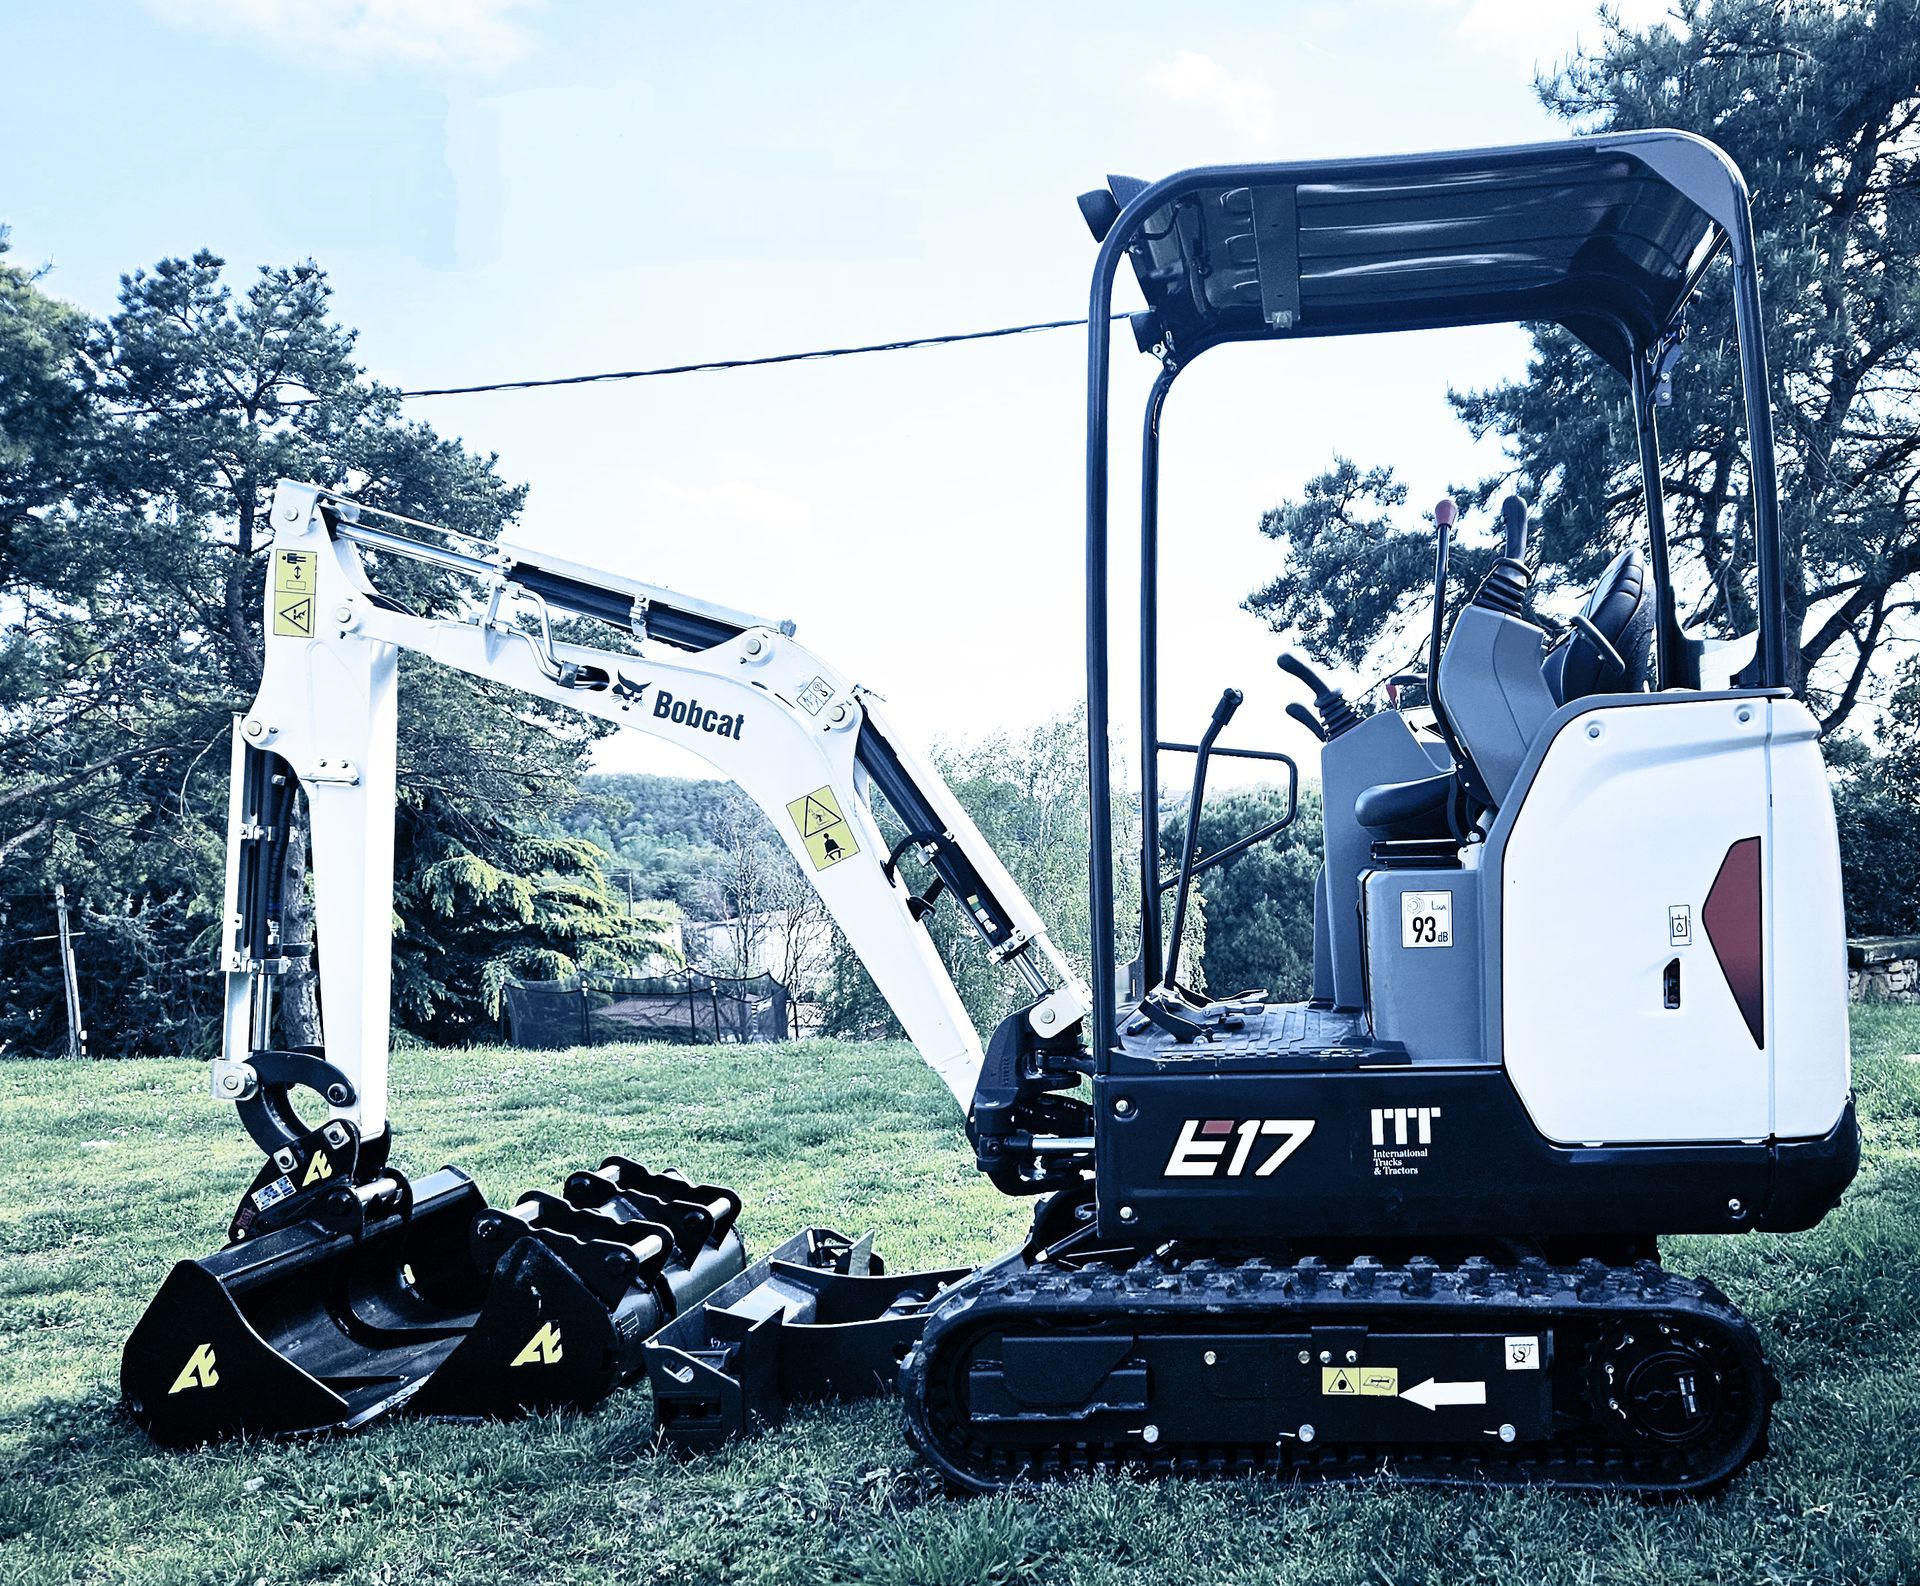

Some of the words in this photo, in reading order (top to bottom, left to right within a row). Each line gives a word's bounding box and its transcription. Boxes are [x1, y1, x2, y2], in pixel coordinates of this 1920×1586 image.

[653, 690, 744, 740] Bobcat
[1412, 916, 1436, 943] 93
[1438, 931, 1449, 942] dB
[1164, 1120, 1315, 1176] E17
[1373, 1148, 1428, 1158] International
[1373, 1158, 1403, 1167] Trucks
[1374, 1167, 1382, 1175] &
[1383, 1166, 1419, 1175] Tractors
